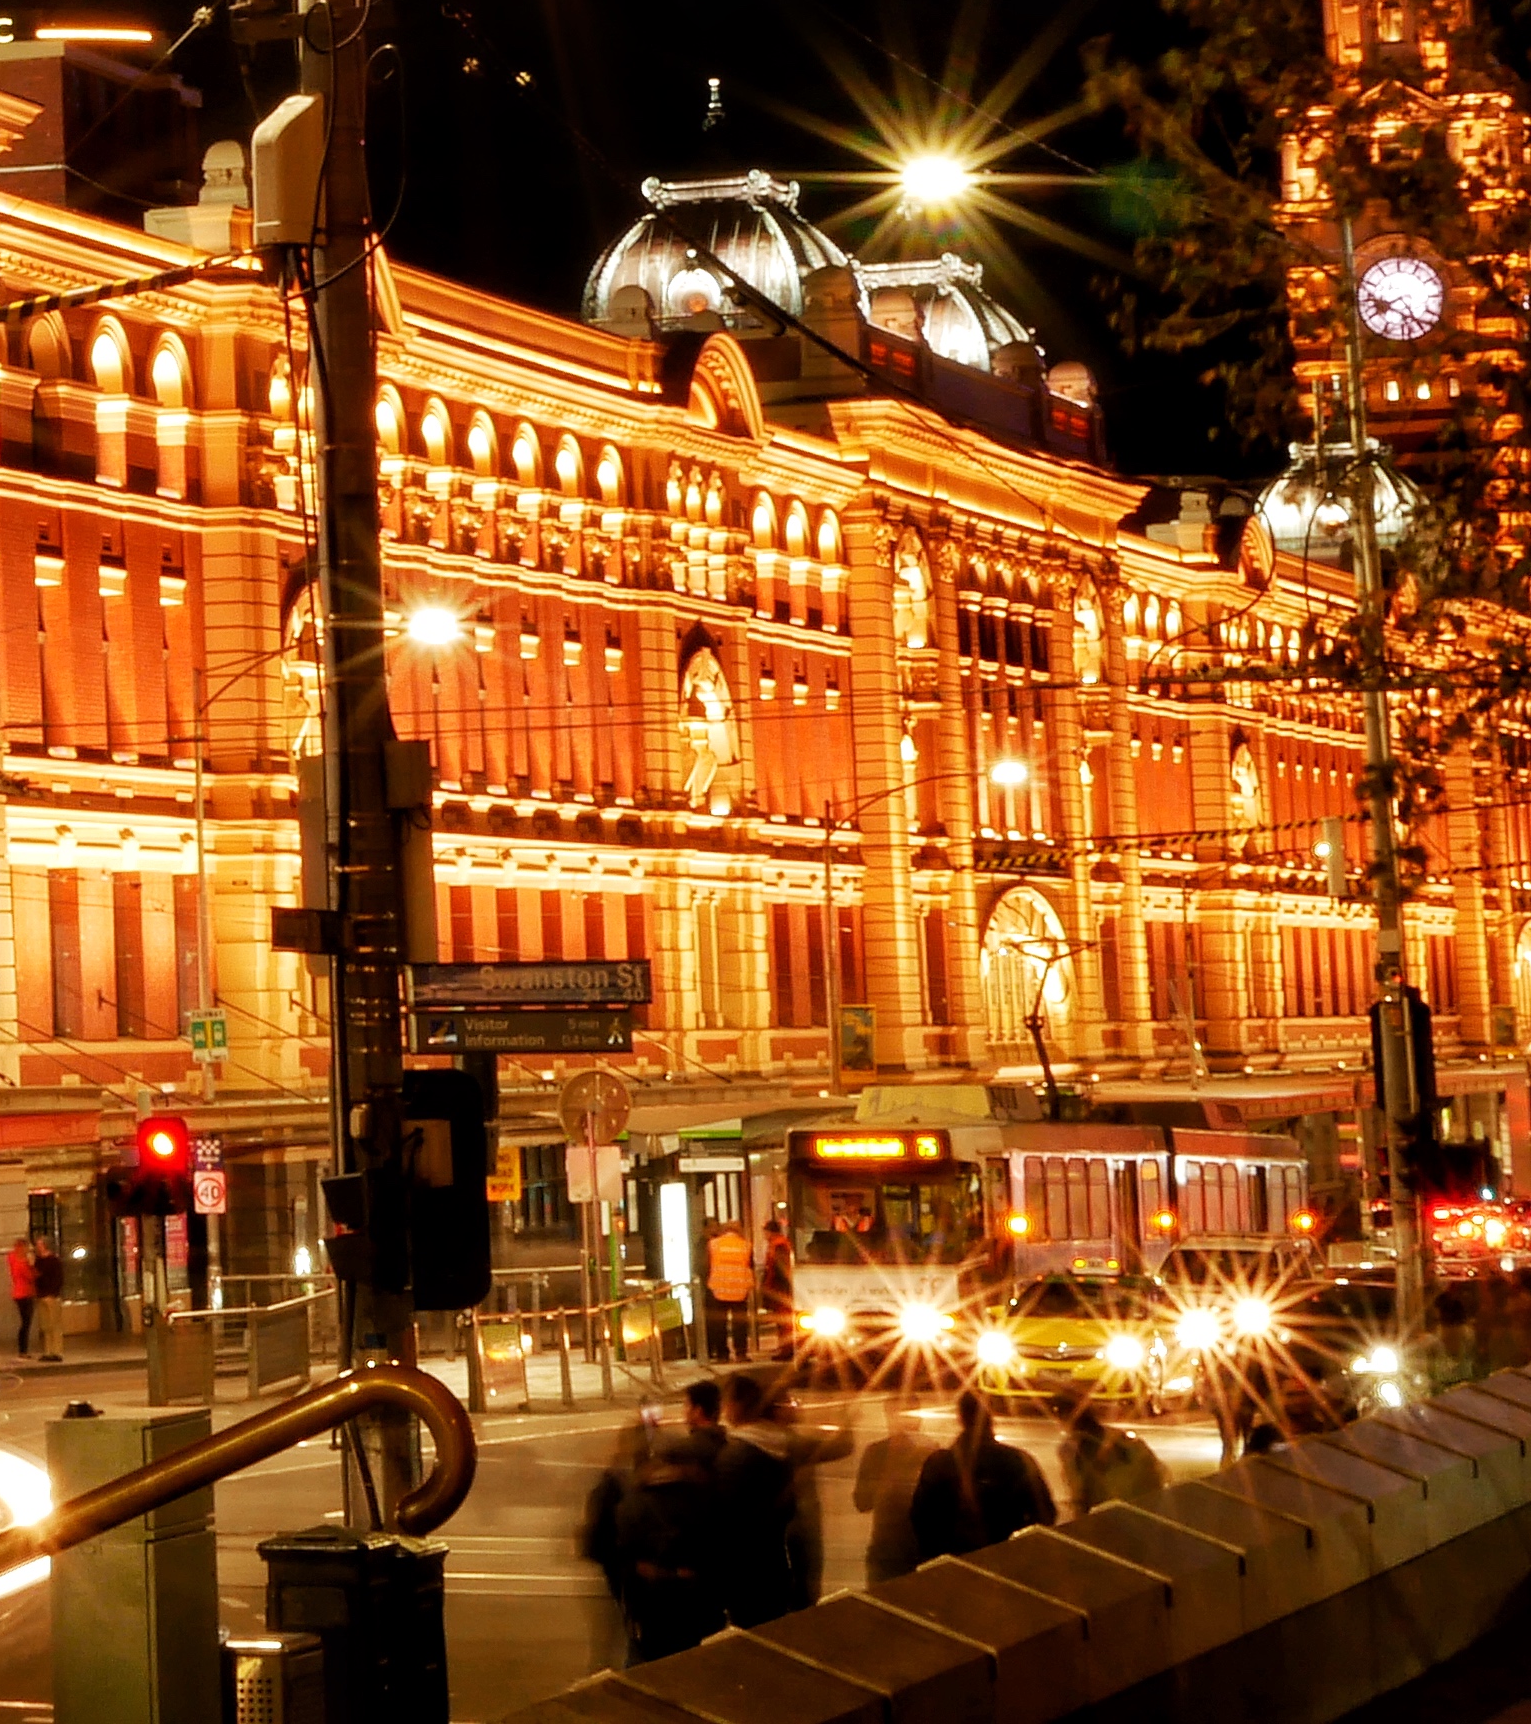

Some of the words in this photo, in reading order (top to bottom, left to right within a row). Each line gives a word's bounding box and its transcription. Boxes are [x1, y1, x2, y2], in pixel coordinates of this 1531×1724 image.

[480, 966, 609, 989] Swanston
[617, 963, 645, 987] St
[464, 1017, 509, 1031] Visitor
[464, 1033, 546, 1048] Information
[200, 1186, 220, 1200] 40
